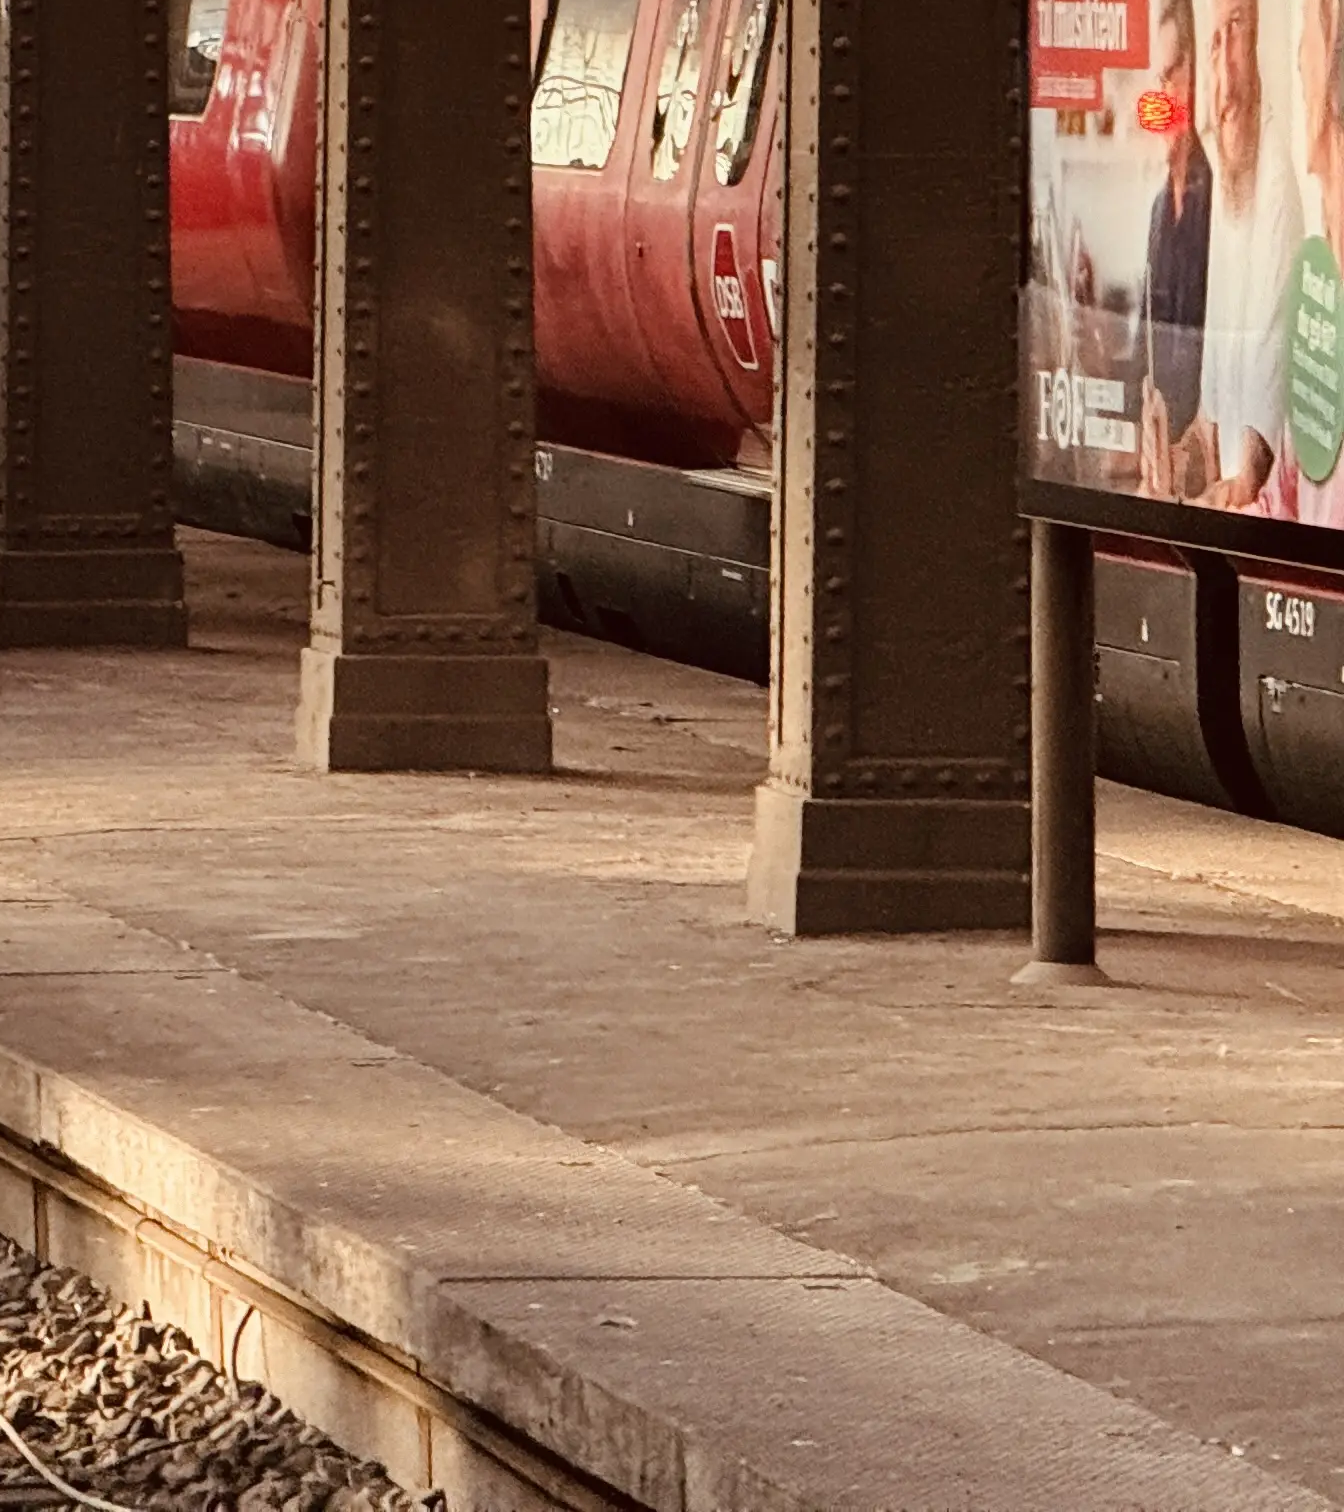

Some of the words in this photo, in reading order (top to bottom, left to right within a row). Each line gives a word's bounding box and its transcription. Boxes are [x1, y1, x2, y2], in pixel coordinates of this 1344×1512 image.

[714, 275, 745, 319] DSB
[1266, 591, 1283, 630] SG
[1285, 597, 1315, 637] 4519
